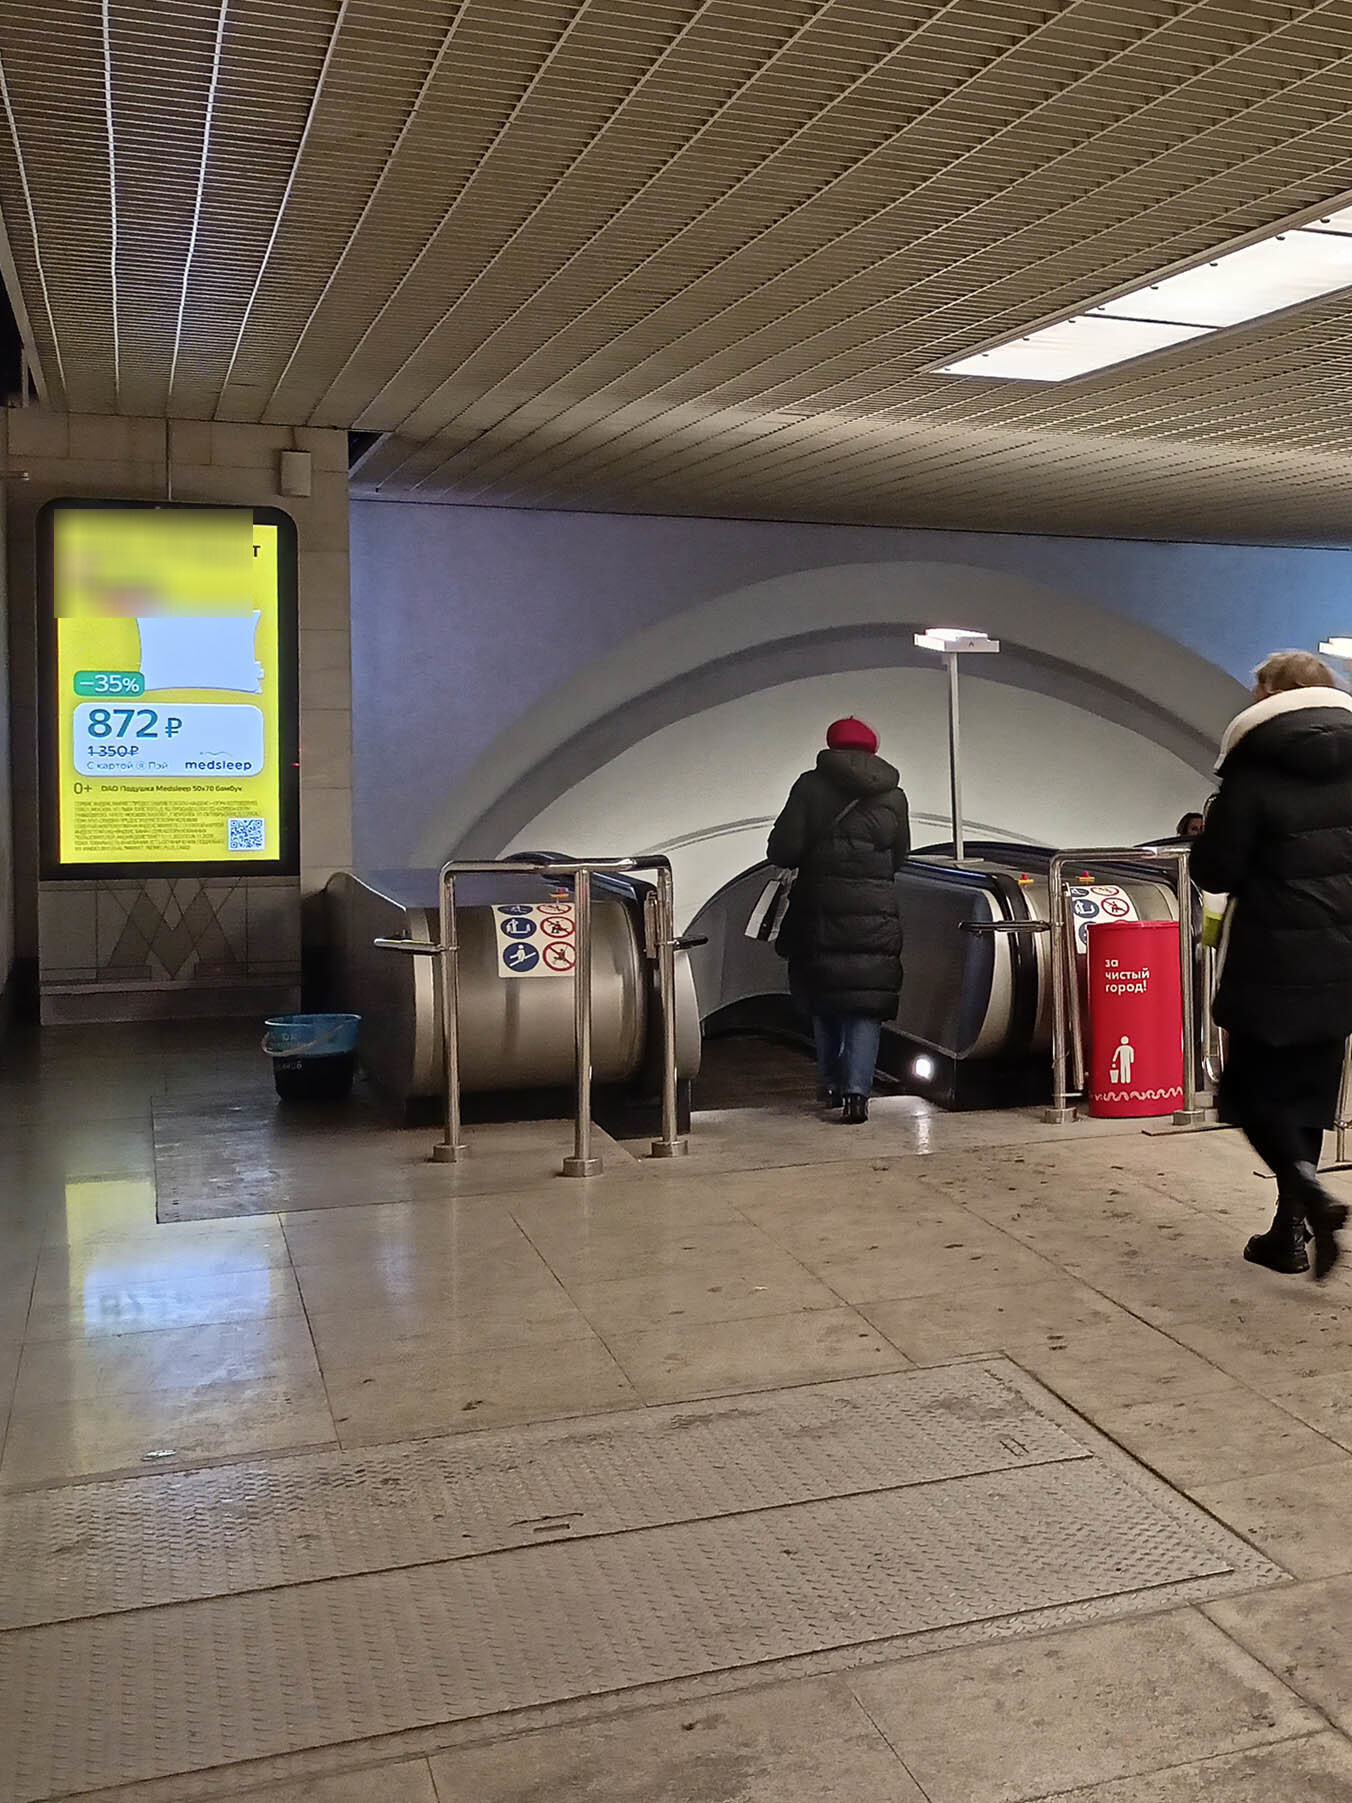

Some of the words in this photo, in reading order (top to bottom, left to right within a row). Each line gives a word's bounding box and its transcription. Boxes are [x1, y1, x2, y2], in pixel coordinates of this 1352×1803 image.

[88, 708, 158, 739] 872
[184, 759, 252, 772] medsleep
[1105, 959, 1119, 968] за
[1105, 967, 1150, 980] чистый
[1105, 980, 1148, 996] город!
